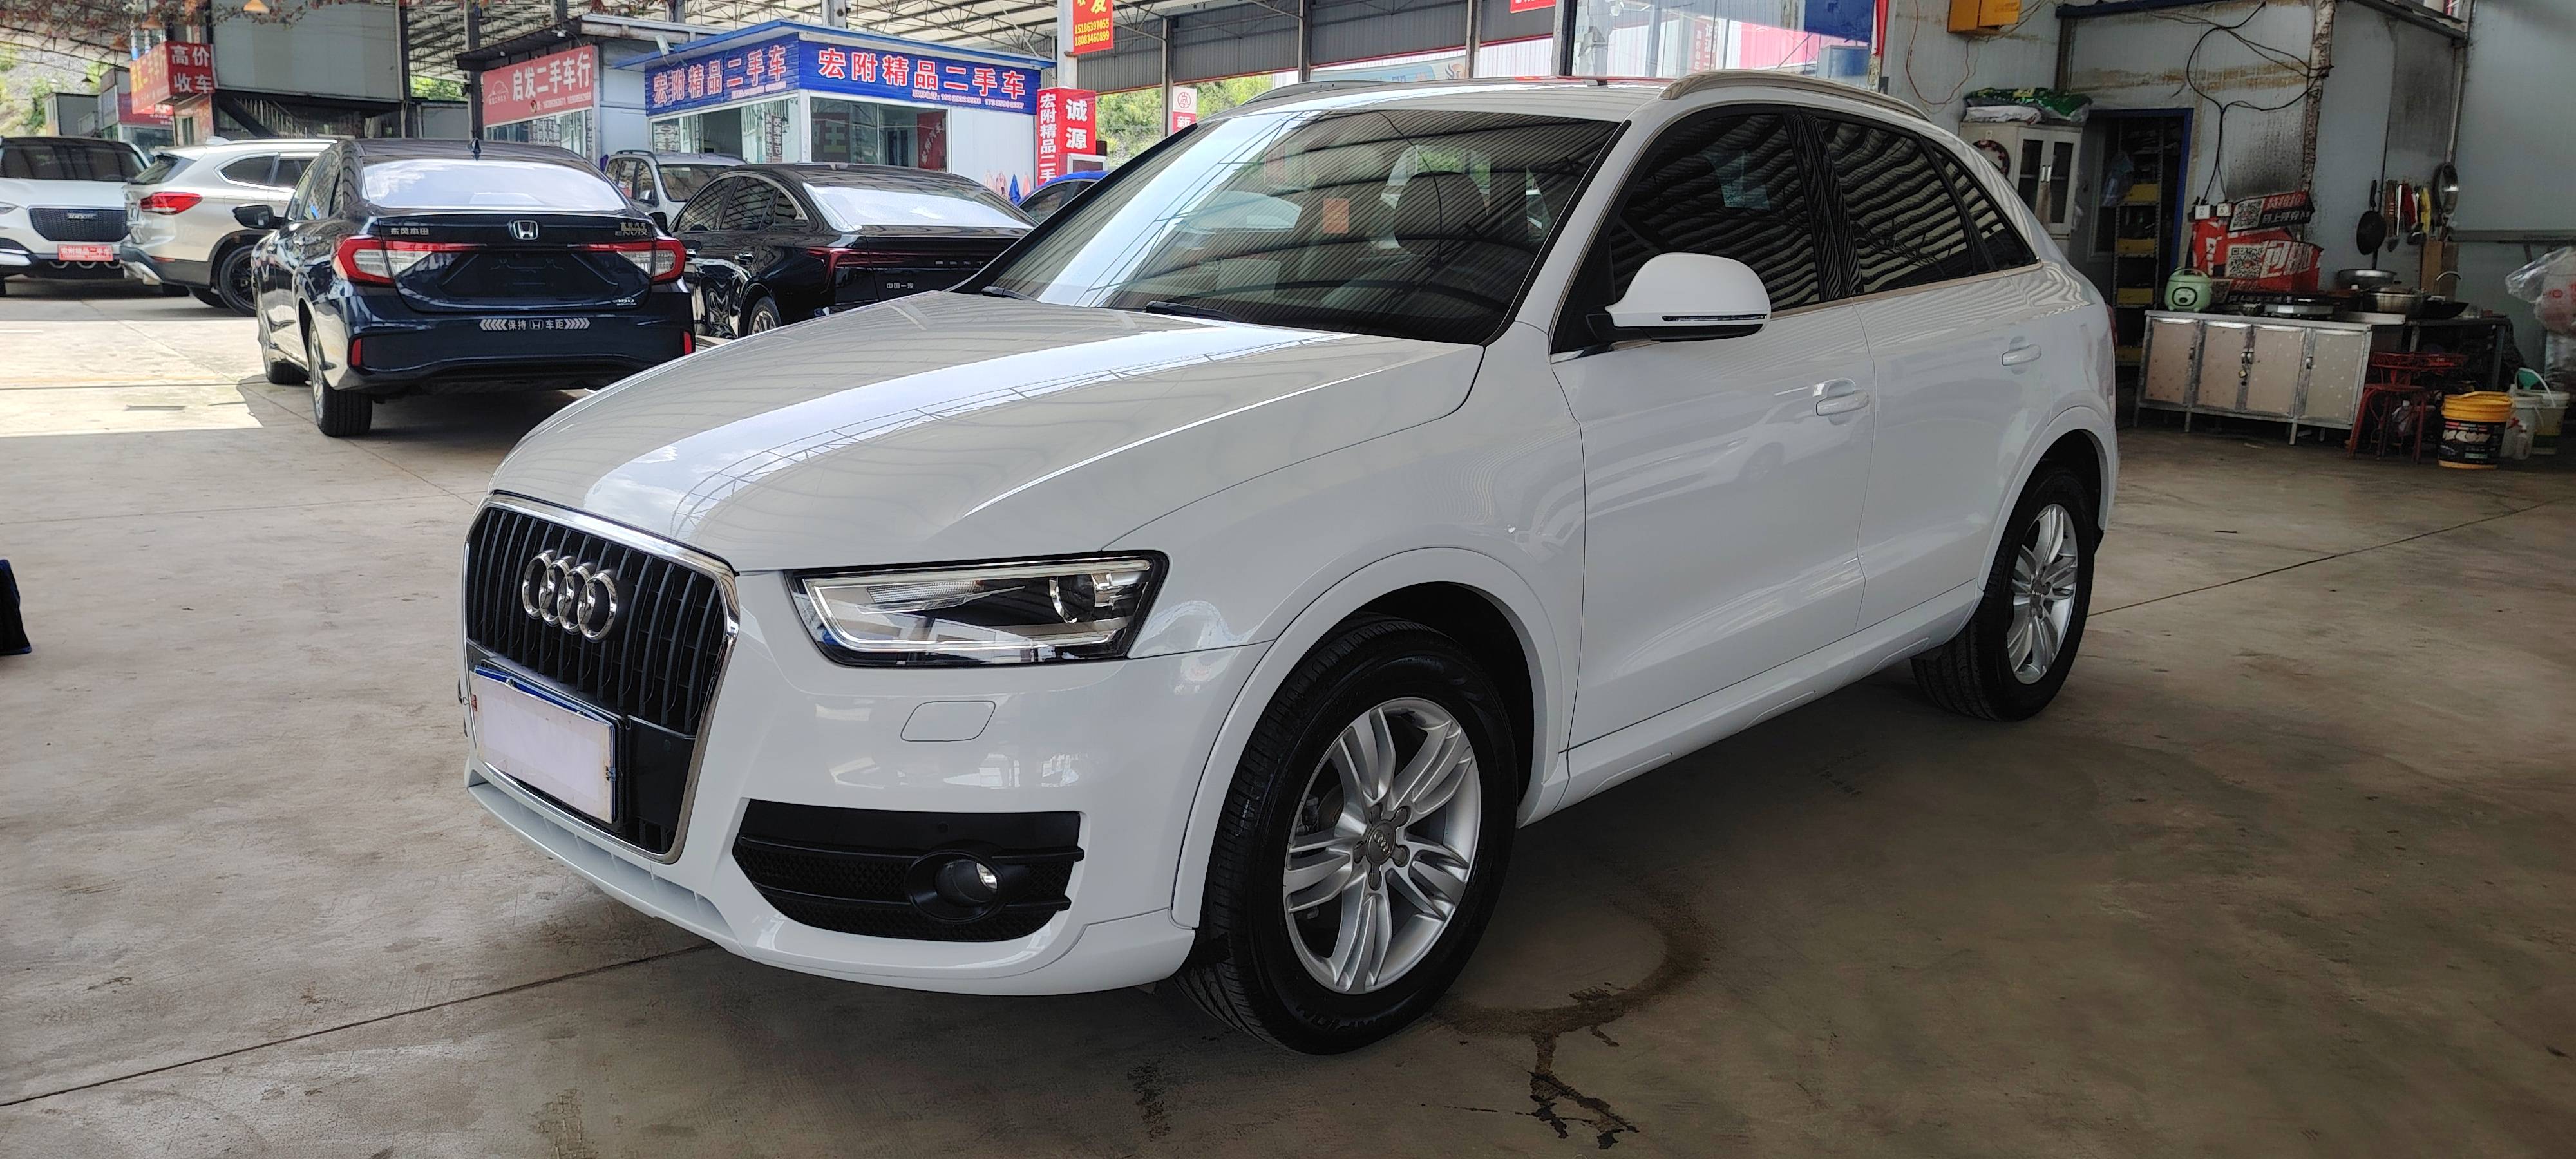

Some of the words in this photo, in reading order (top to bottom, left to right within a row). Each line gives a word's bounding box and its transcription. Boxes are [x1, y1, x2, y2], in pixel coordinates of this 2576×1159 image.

[1074, 18, 1110, 34] 15186397055
[170, 44, 210, 67] 高价
[513, 51, 591, 101] 启发二手车行
[653, 44, 786, 105] 宏附精品二手车
[818, 48, 1026, 100] 宏附精品二手车
[173, 72, 214, 93] 收车
[1039, 93, 1057, 182] 宏附精品二手
[1065, 99, 1088, 150] 诚源
[508, 319, 527, 330] 保持
[545, 319, 564, 330] 车距
